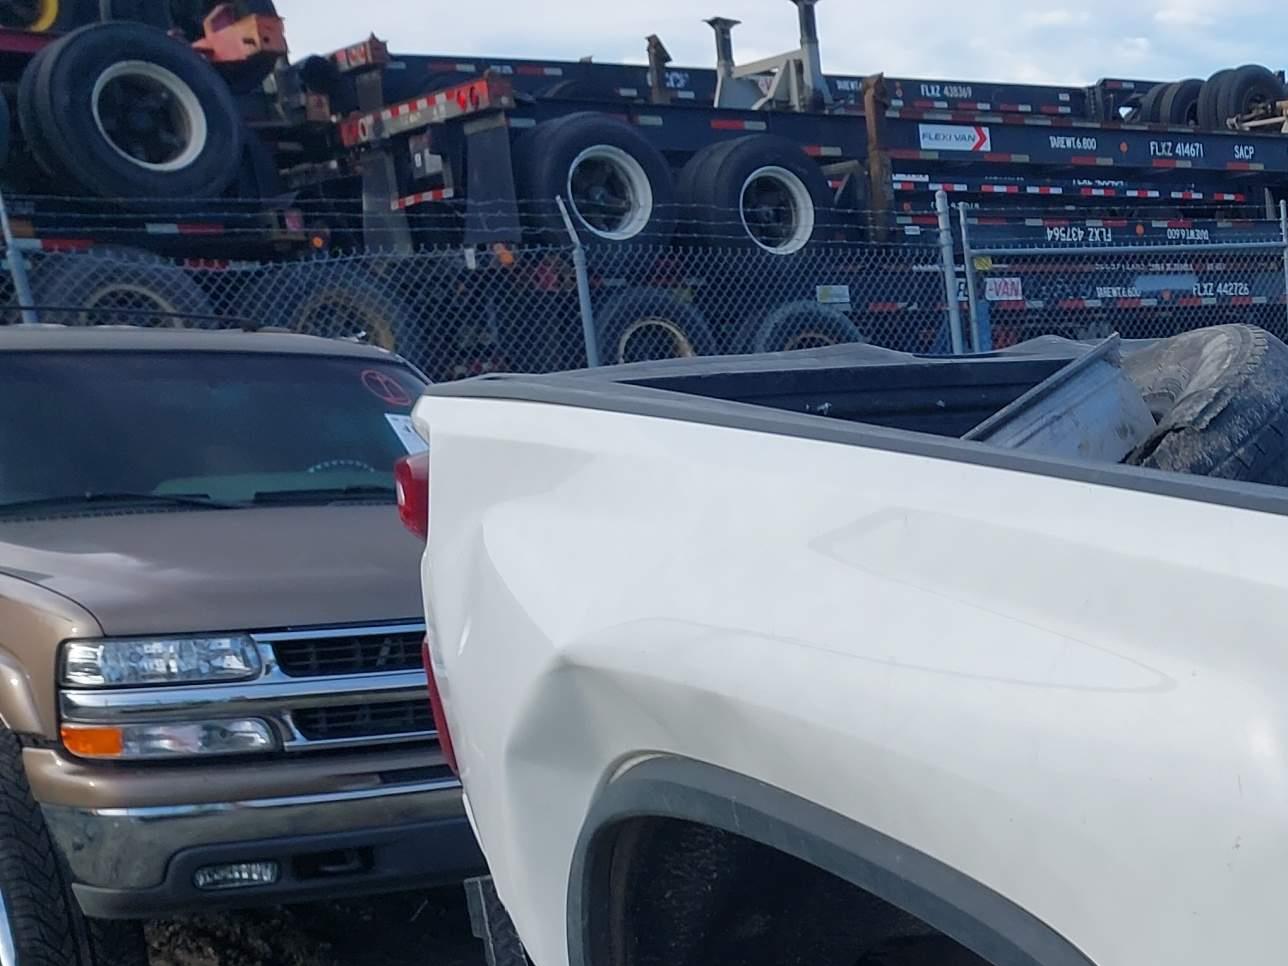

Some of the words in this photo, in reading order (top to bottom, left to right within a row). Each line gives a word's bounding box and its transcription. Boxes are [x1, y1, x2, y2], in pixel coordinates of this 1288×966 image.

[1149, 141, 1173, 156] FLXZ
[1175, 142, 1204, 158] 414671
[1233, 144, 1255, 159] SACP
[1046, 226, 1084, 241] 437564
[1088, 227, 1112, 242] FLXZ
